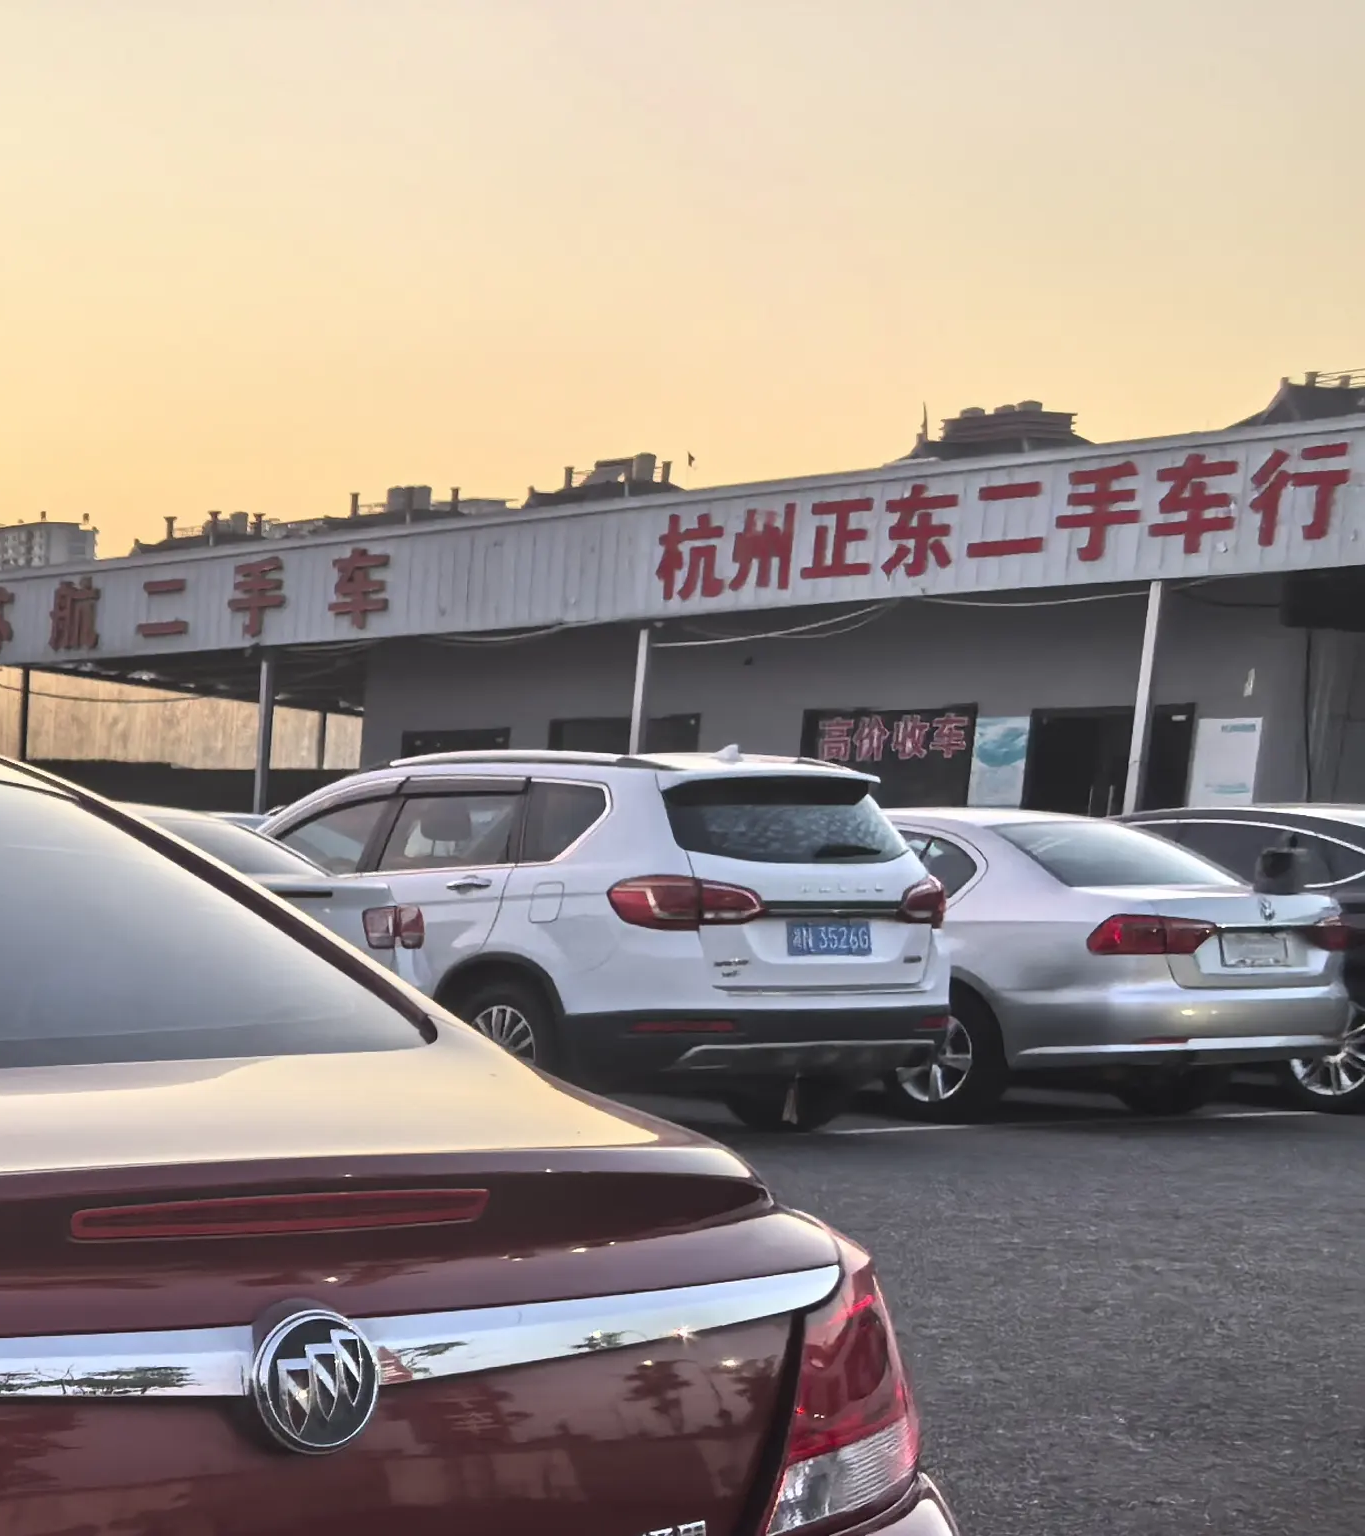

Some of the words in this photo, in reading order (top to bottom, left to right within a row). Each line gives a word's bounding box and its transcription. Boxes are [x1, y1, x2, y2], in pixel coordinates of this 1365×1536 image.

[655, 441, 1351, 601] 杭州正东二手车行
[817, 712, 970, 763] 高价收车
